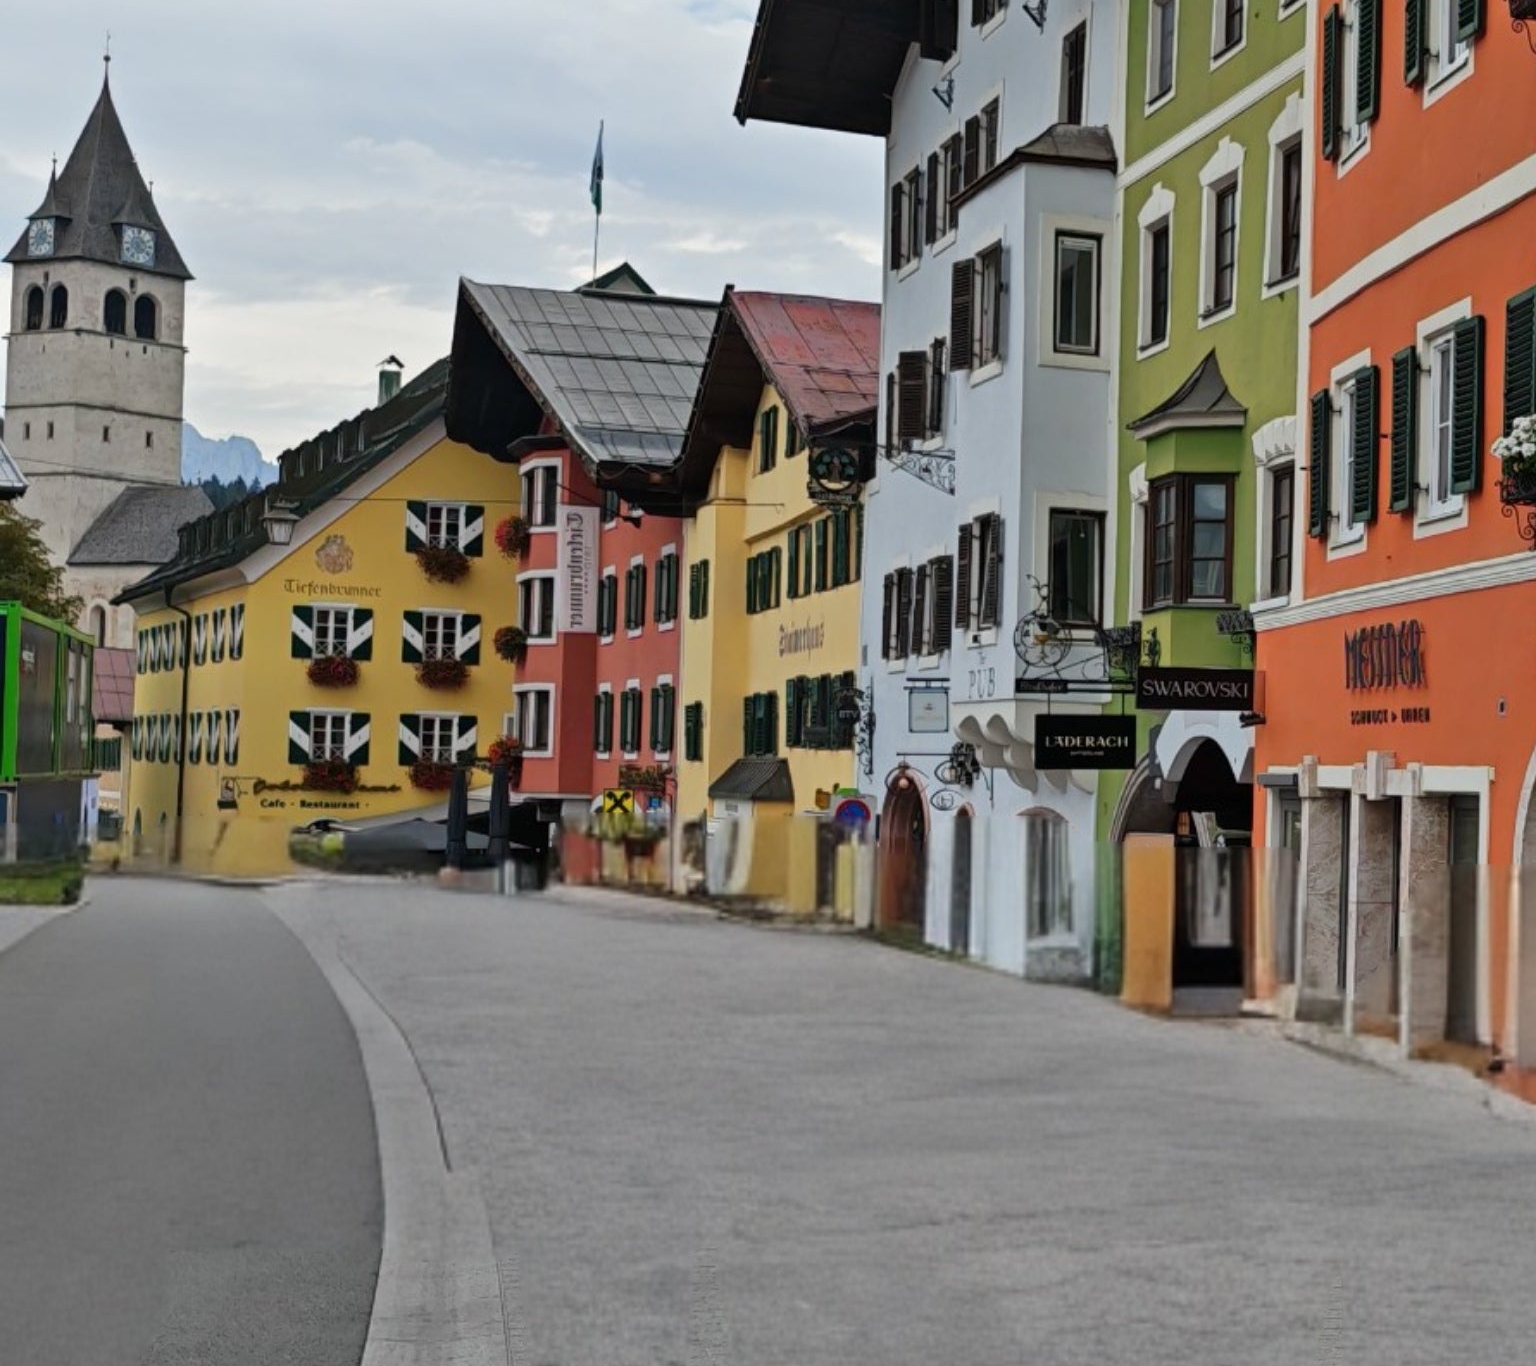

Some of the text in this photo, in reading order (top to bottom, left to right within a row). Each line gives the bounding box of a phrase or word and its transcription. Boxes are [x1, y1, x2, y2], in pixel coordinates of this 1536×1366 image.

[283, 578, 383, 597] Tiefenbrunner
[968, 666, 996, 700] PUB
[1142, 679, 1250, 700] SWAROVSKI
[299, 799, 360, 810] Restaurant
